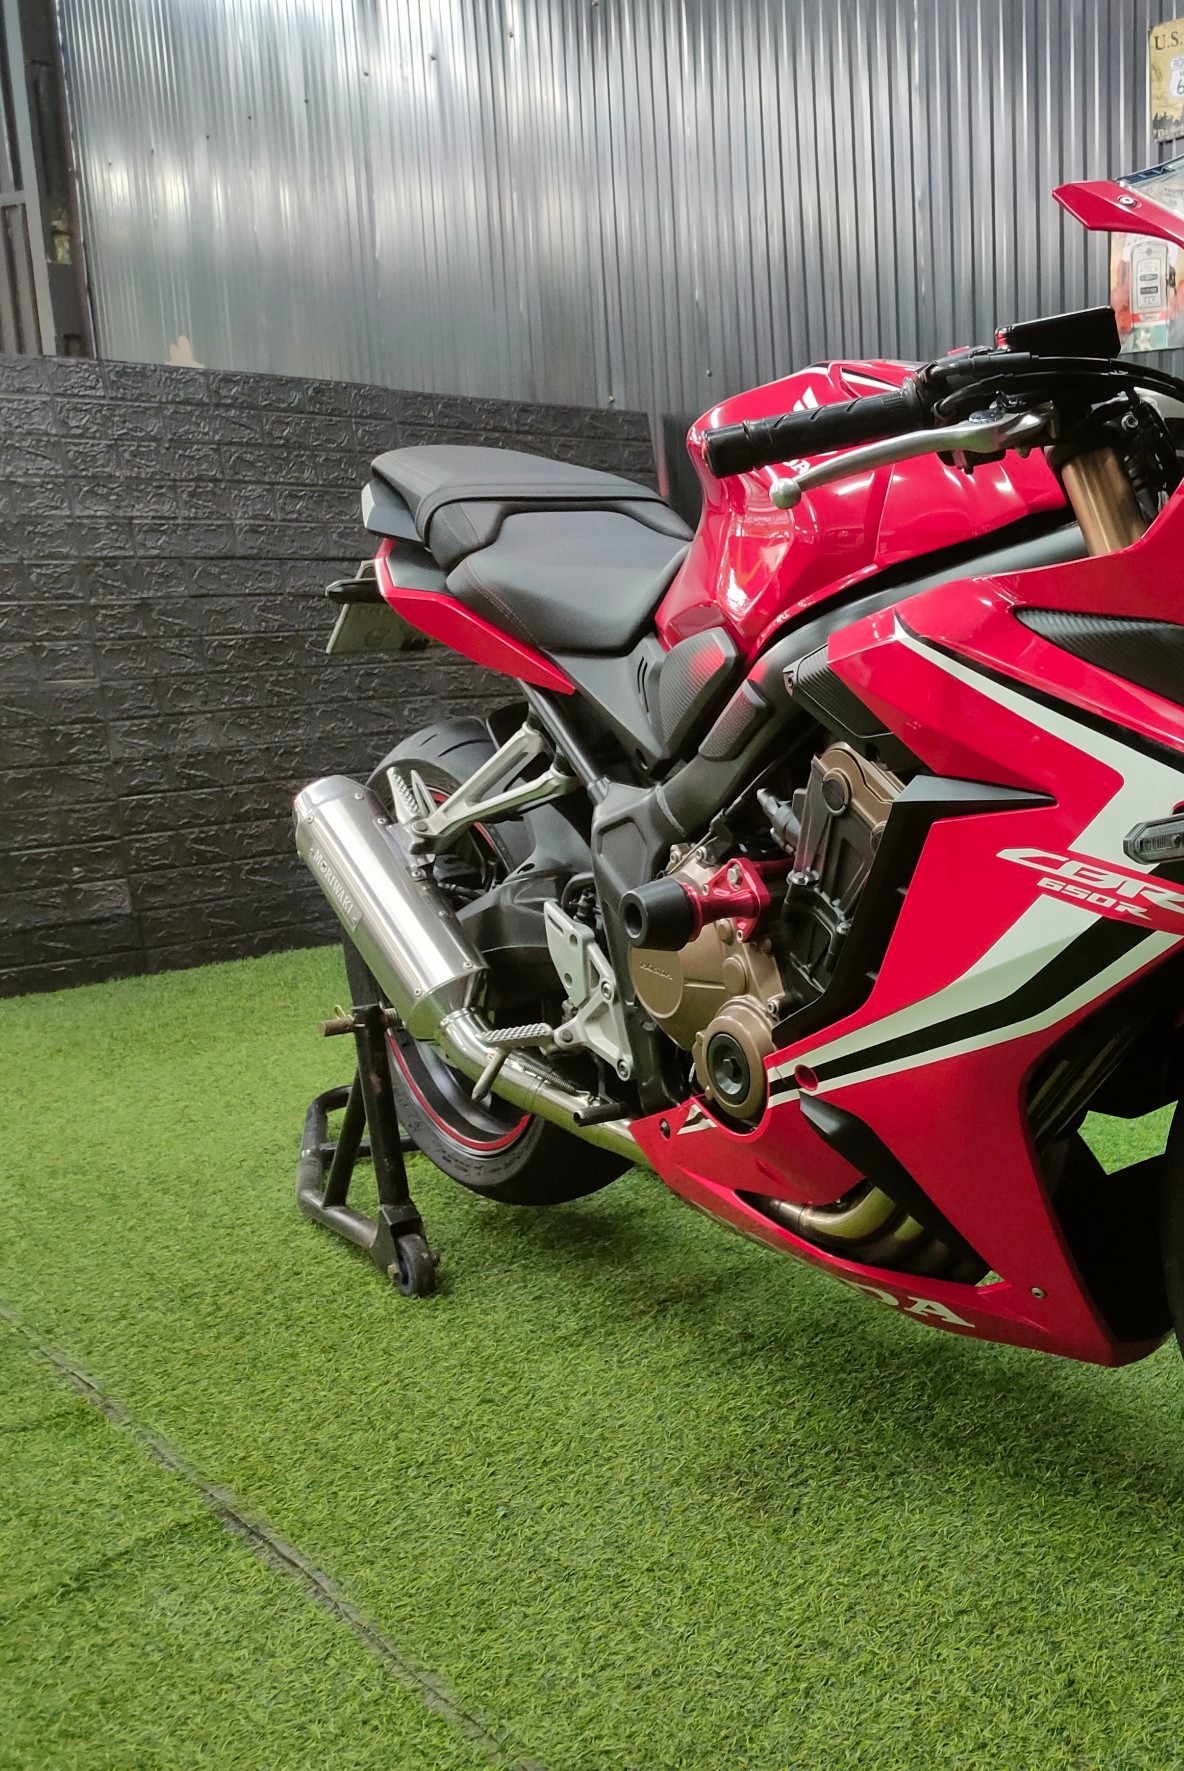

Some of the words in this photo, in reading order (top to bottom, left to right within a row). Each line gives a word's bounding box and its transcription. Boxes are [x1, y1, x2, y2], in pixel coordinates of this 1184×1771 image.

[1154, 31, 1183, 51] U.S.
[313, 849, 354, 914] MORIWAKI
[1036, 877, 1153, 921] 650R
